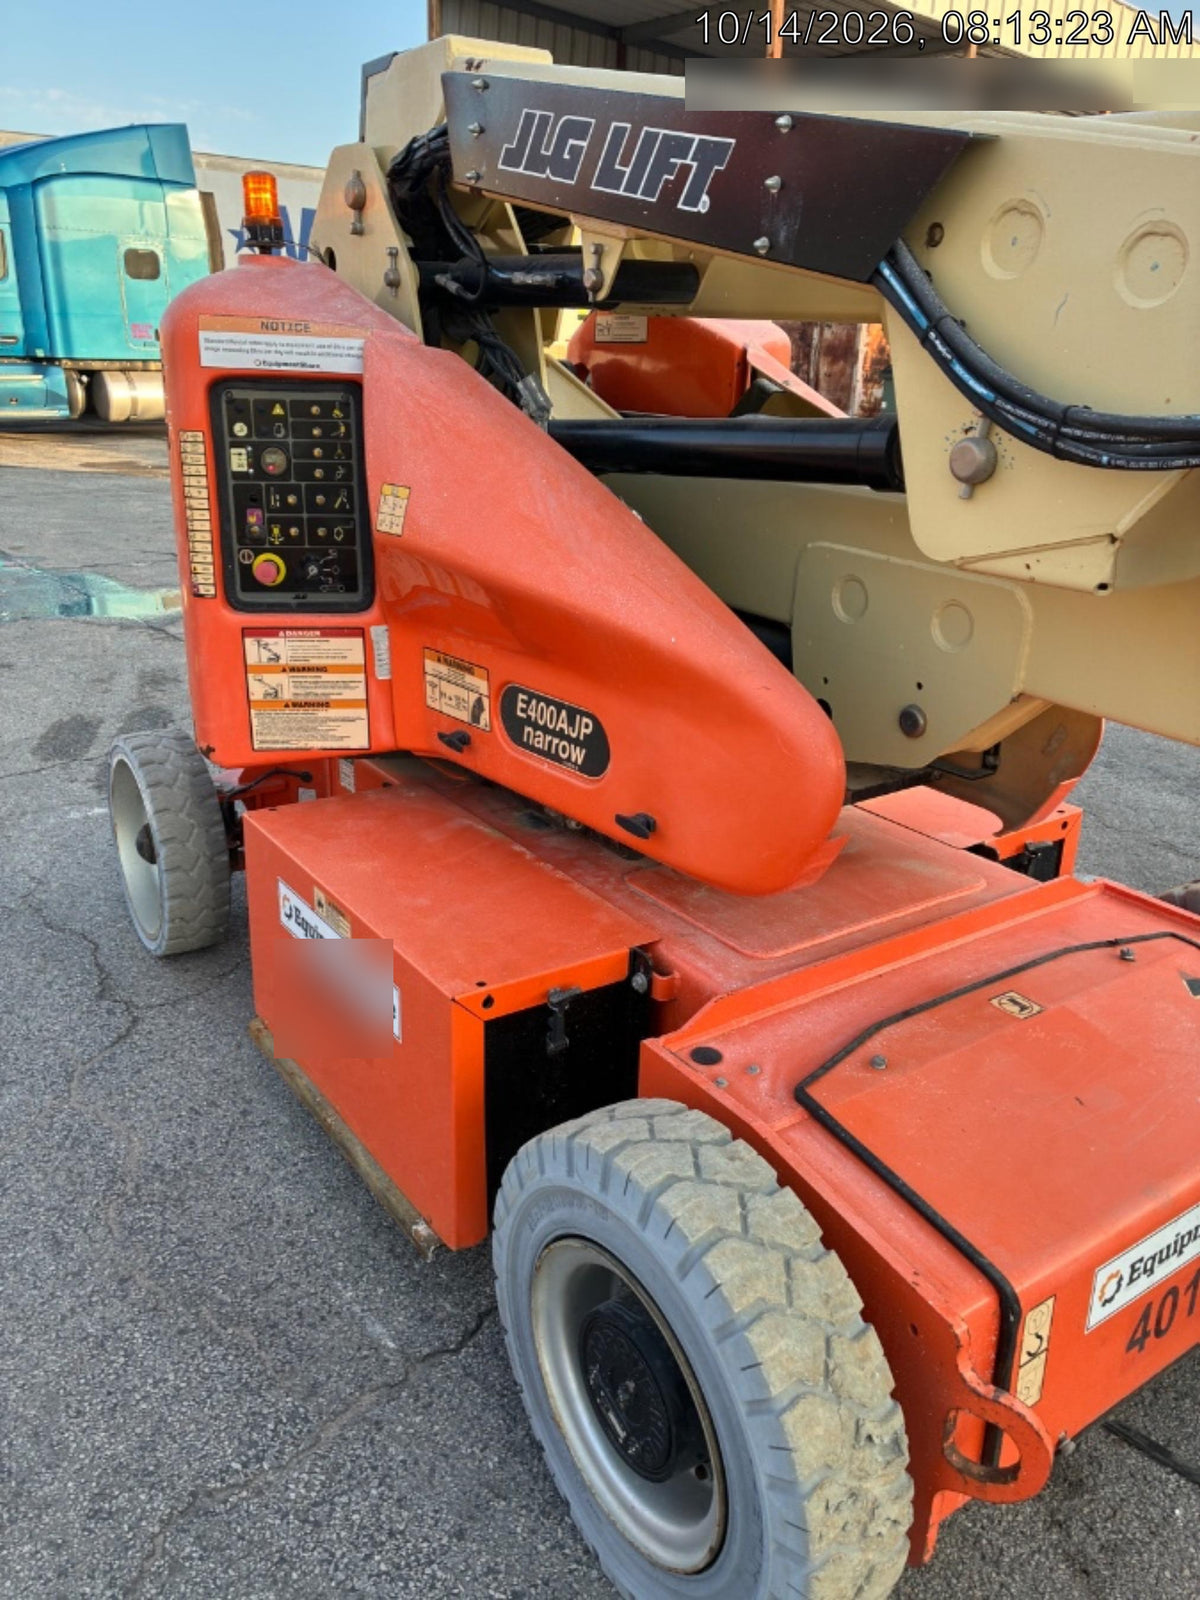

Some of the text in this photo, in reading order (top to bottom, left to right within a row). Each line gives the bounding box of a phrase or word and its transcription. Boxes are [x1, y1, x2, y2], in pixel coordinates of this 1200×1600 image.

[498, 108, 597, 185] JLG
[260, 320, 312, 333] NOTICE
[516, 692, 594, 741] E400AJP
[523, 724, 586, 766] narrow
